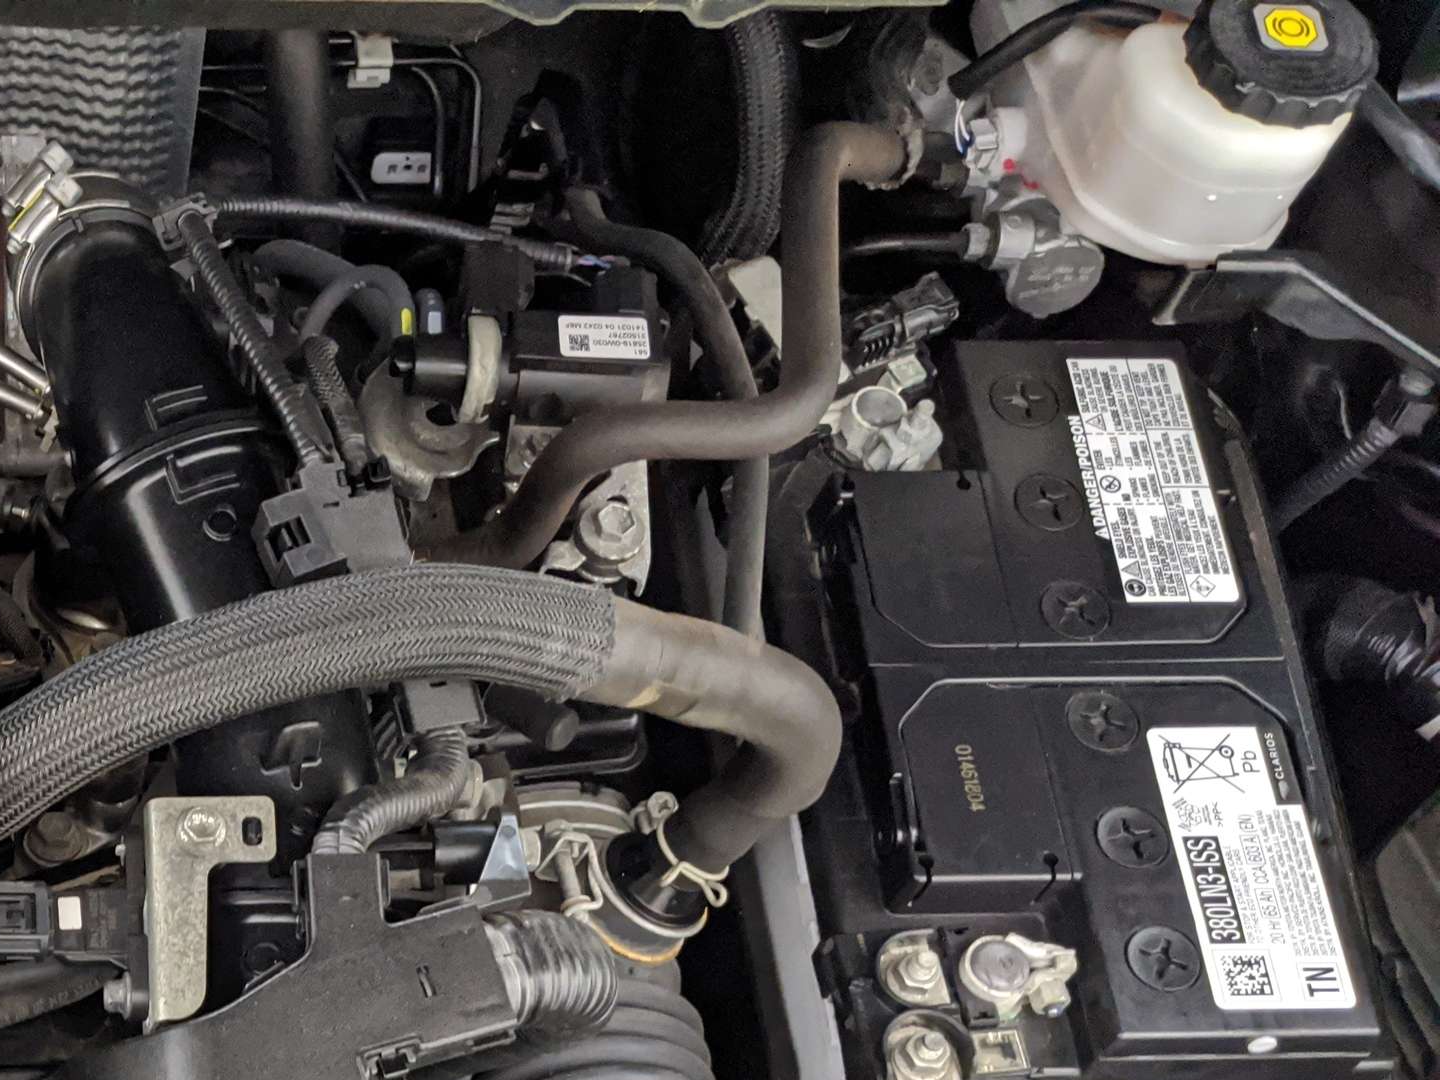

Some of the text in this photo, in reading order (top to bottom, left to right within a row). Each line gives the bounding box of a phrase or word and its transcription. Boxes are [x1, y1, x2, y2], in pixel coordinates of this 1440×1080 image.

[1068, 415, 1105, 526] DANGER/POISON
[1239, 750, 1261, 772] Pb
[1264, 731, 1285, 779] CLARIOS
[1186, 837, 1242, 940] 380LN3-ISS
[1302, 966, 1341, 996] TN
